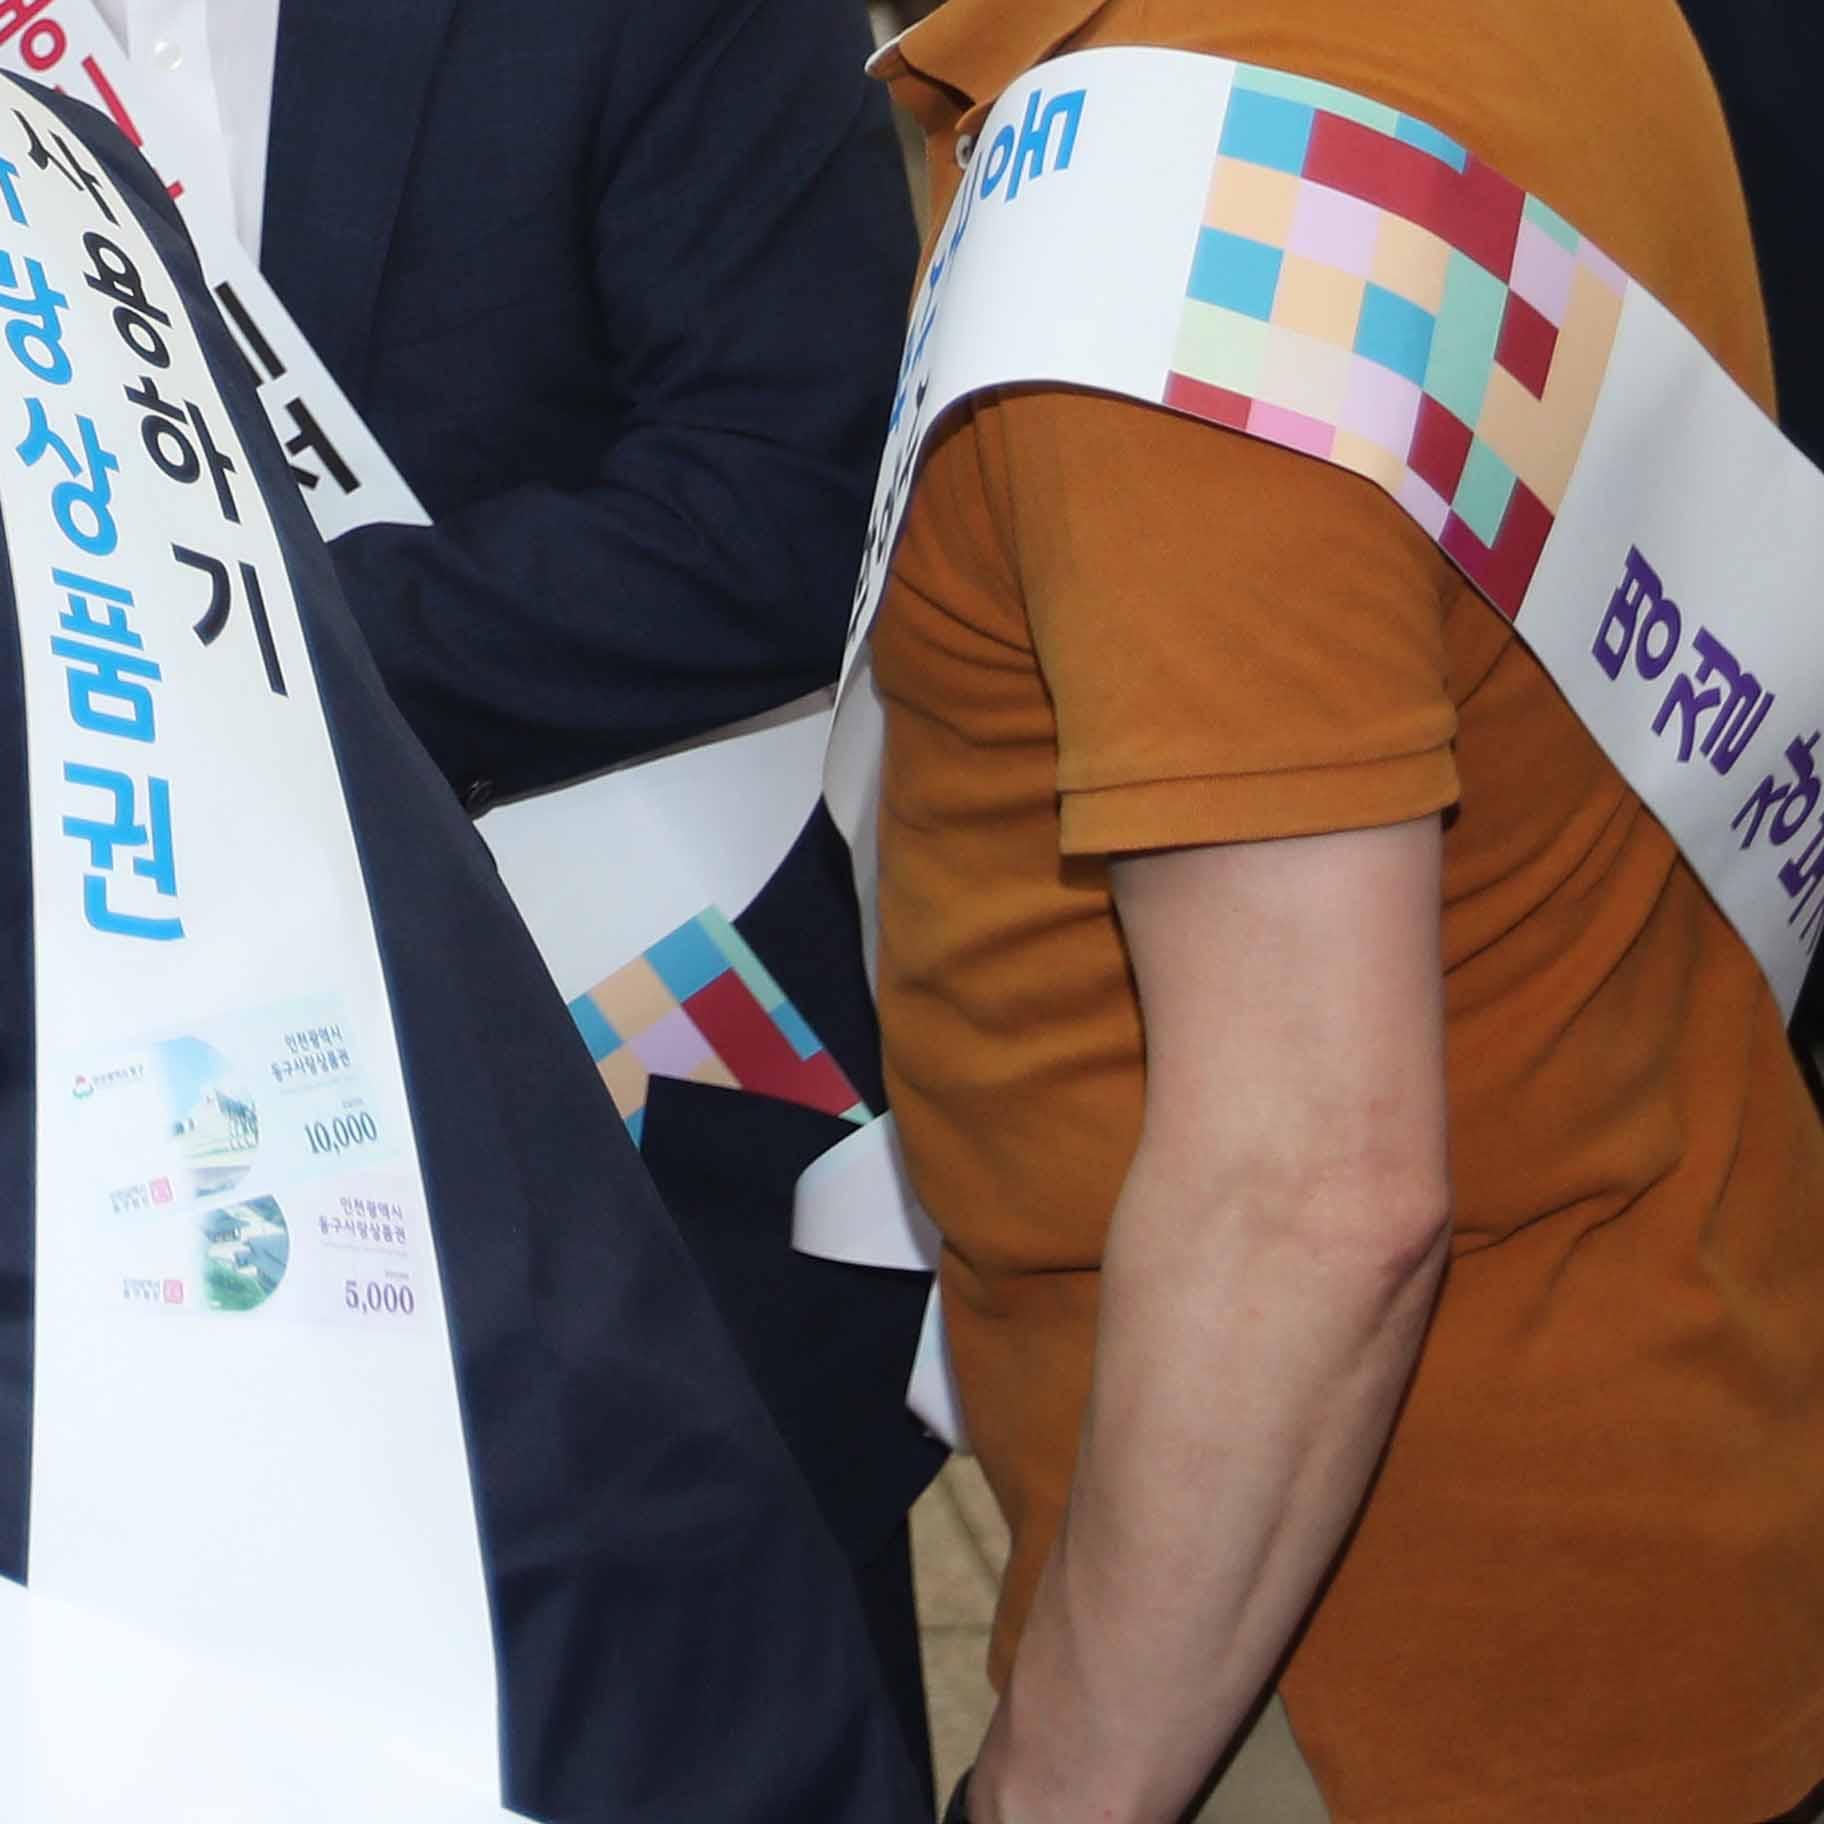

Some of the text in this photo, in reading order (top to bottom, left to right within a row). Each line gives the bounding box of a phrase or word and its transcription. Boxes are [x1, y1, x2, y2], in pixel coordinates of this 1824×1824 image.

[1591, 543, 1776, 776] 명절
[304, 1111, 378, 1156] 10,000
[344, 1279, 415, 1316] 5,000
